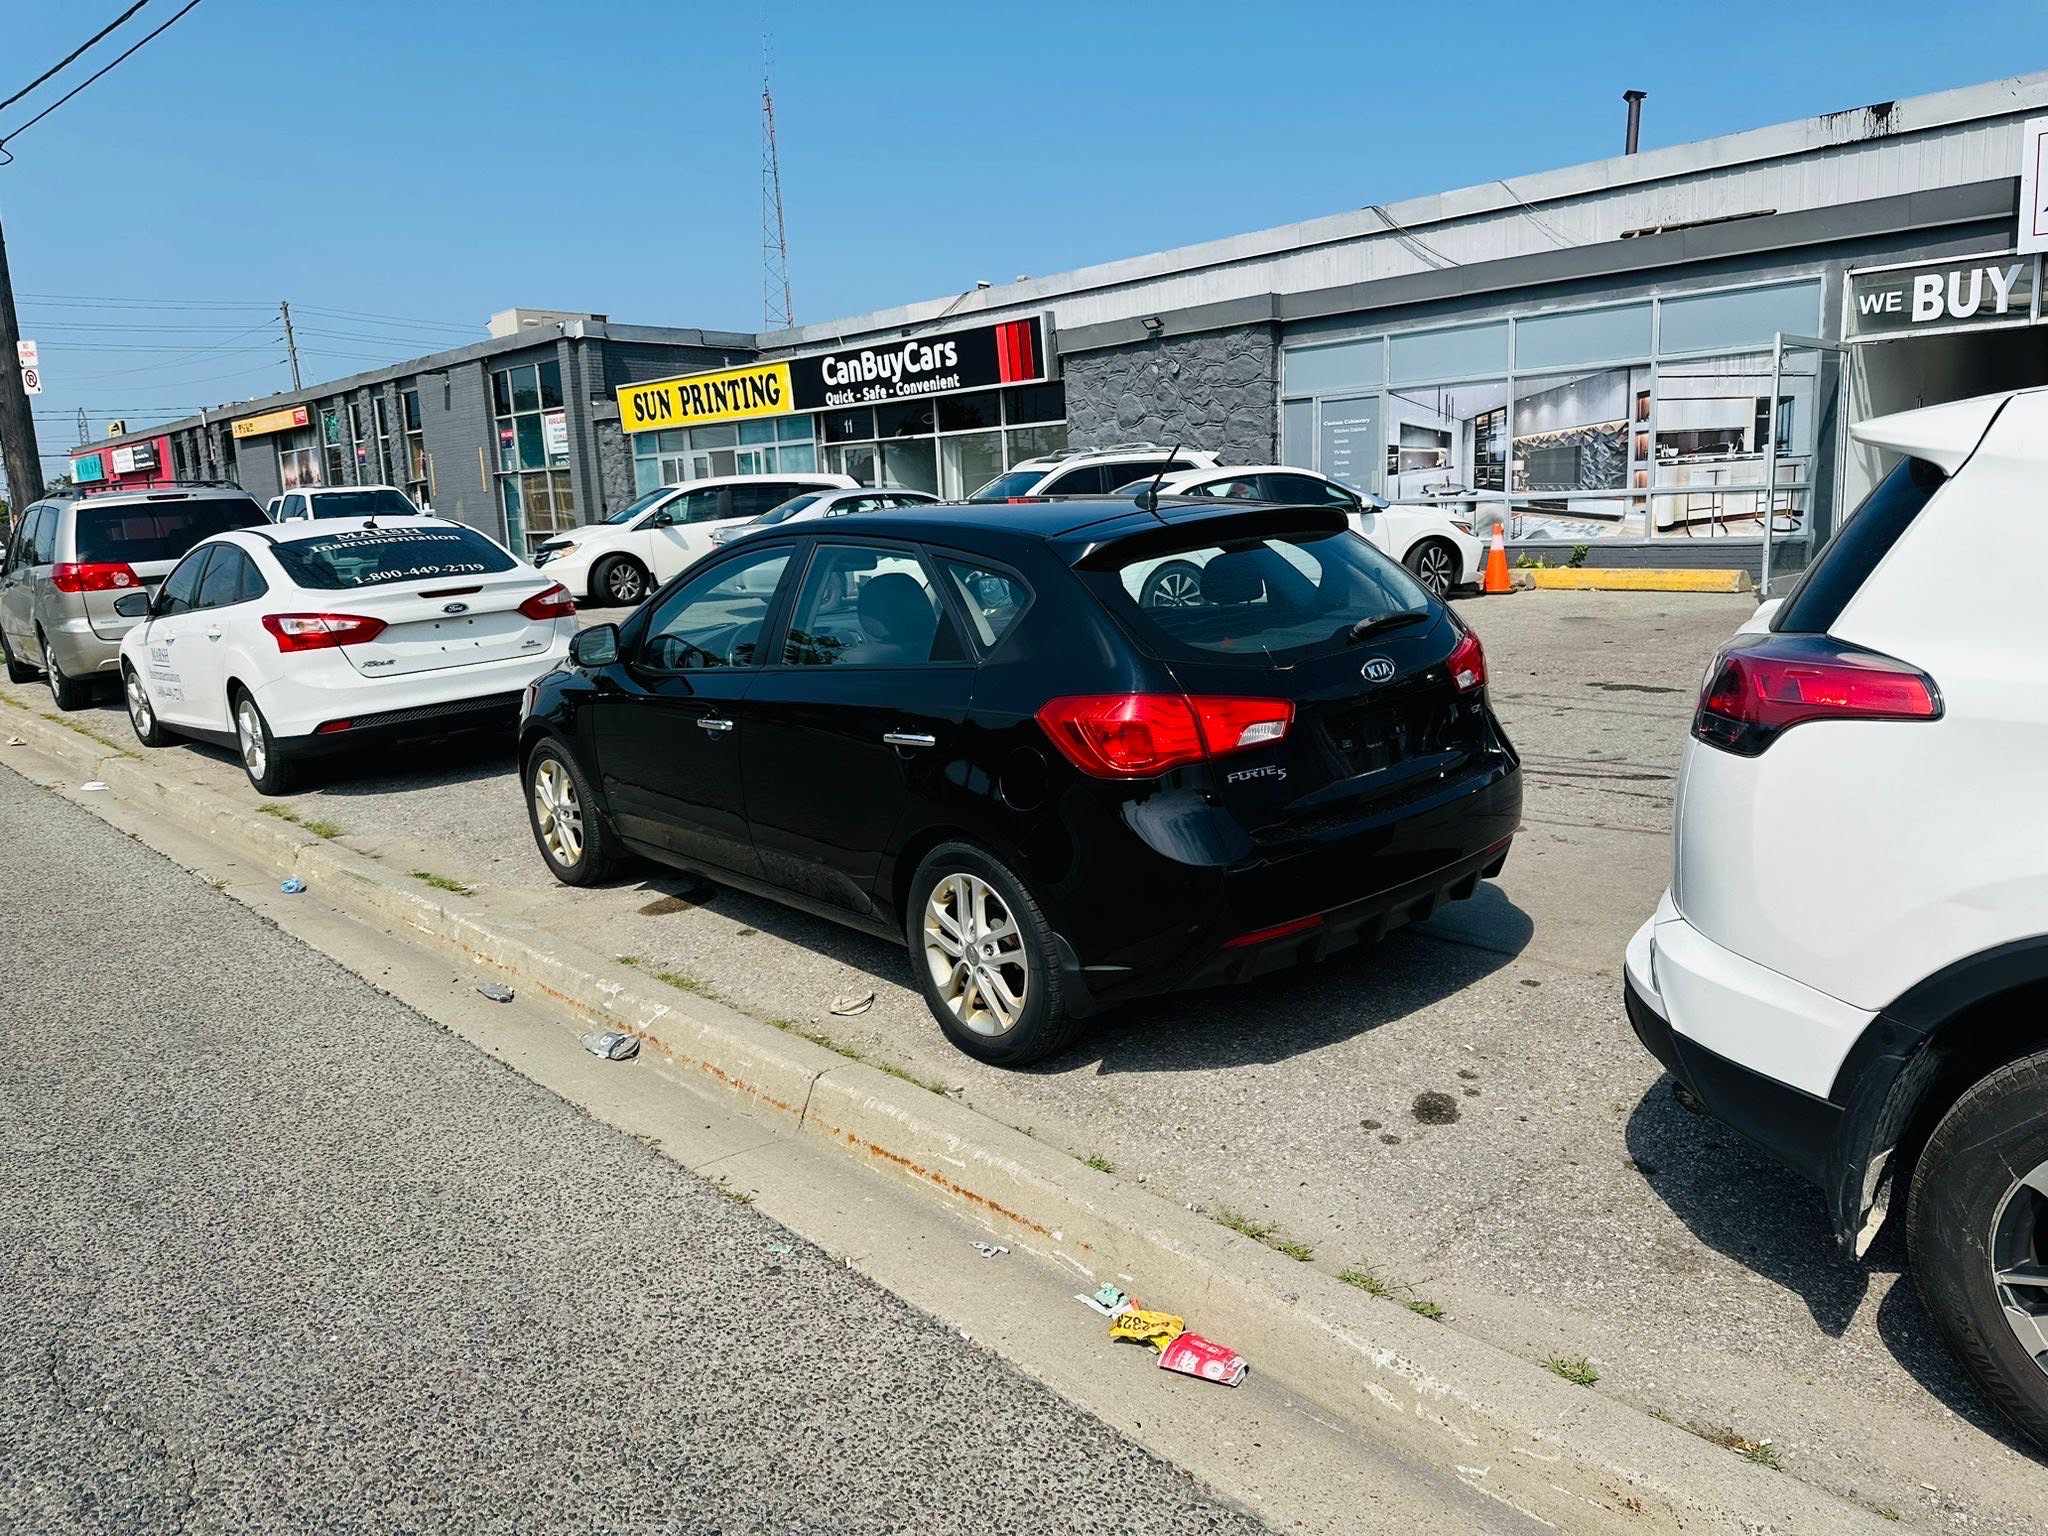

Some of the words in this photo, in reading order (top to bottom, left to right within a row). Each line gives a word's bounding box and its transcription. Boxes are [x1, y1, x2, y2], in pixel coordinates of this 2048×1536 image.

[1859, 291, 1902, 316] WE
[1911, 263, 2025, 323] BUY
[822, 341, 958, 386] CanBuyCars
[633, 389, 672, 422] SUN
[678, 373, 781, 416] PRINTING
[825, 389, 855, 406] Quick
[863, 385, 888, 401] Safe
[896, 373, 960, 396] Convenient
[843, 419, 853, 434] 11
[310, 534, 461, 553] Instrumentation
[336, 528, 423, 542] MARSH
[353, 563, 485, 585] 1-800-449-2719
[449, 603, 465, 614] Ford
[1367, 665, 1392, 678] KIA
